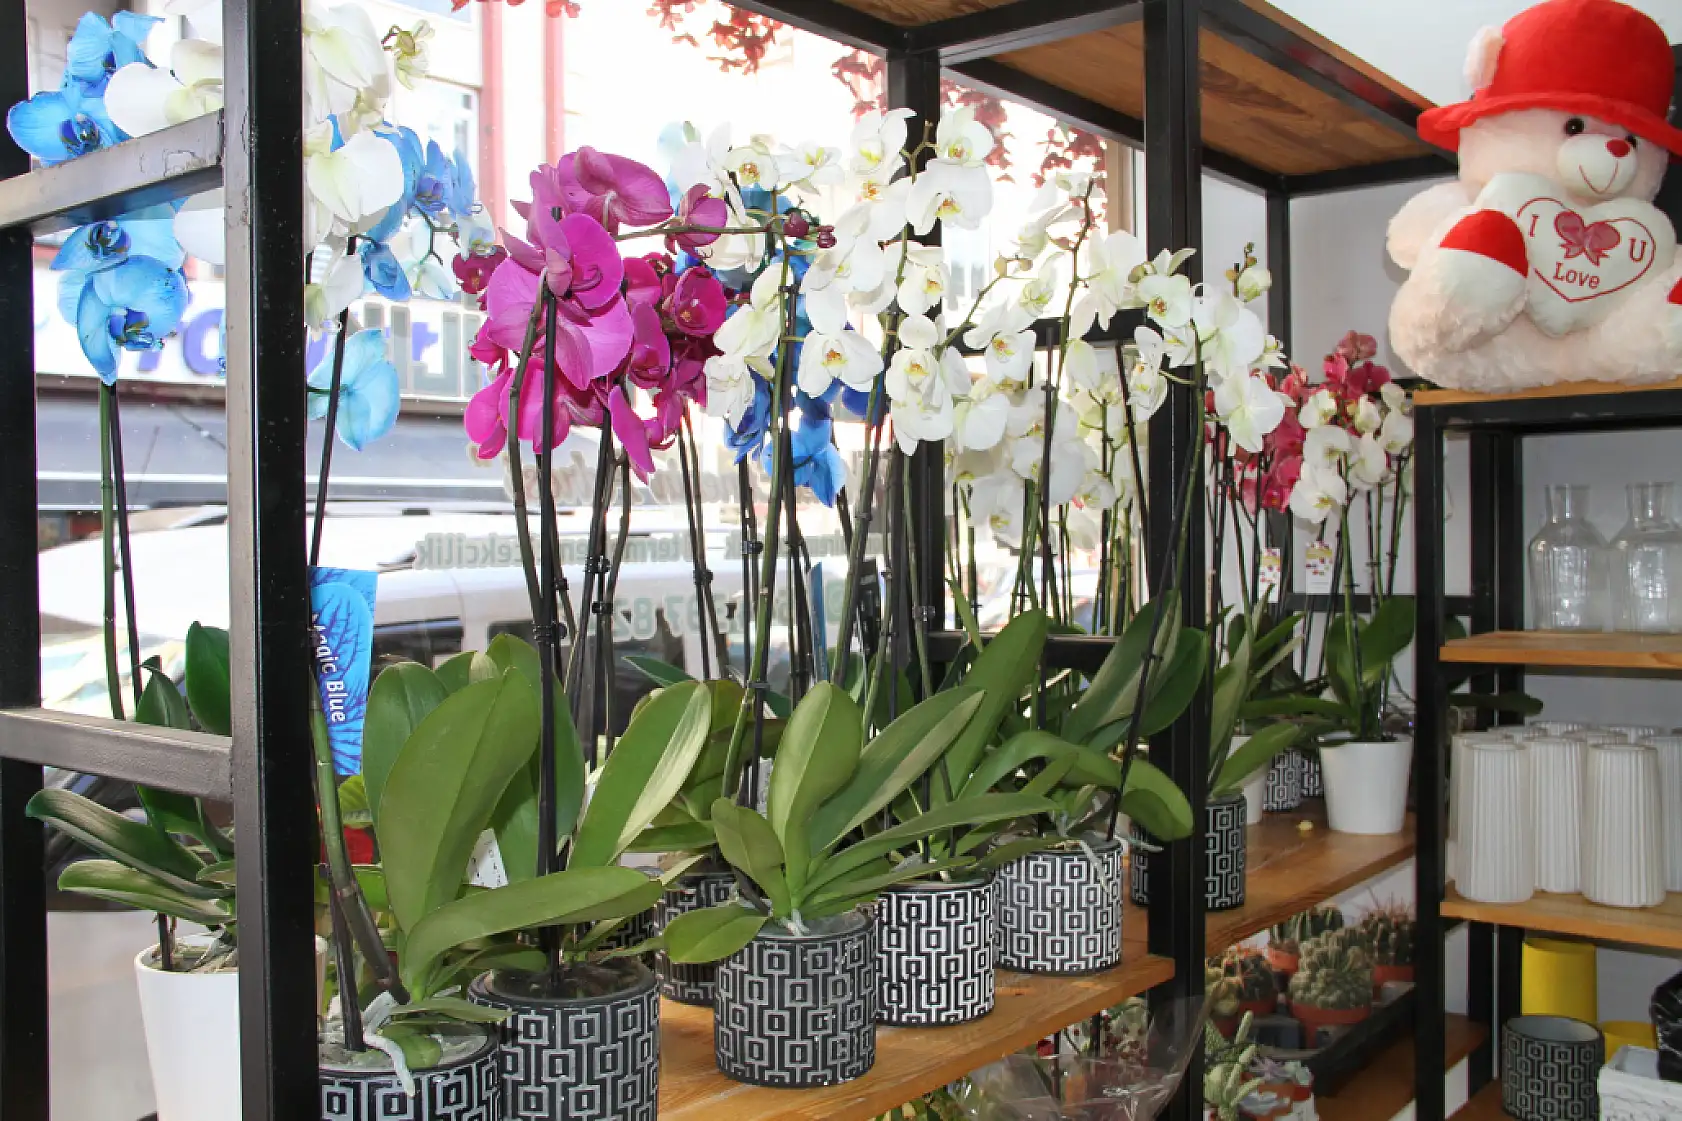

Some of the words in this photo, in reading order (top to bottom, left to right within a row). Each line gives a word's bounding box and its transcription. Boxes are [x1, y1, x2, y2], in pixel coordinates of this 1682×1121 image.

[1529, 214, 1540, 237] I
[1630, 237, 1647, 262] U
[1553, 261, 1600, 289] Love
[326, 679, 349, 723] Blue
